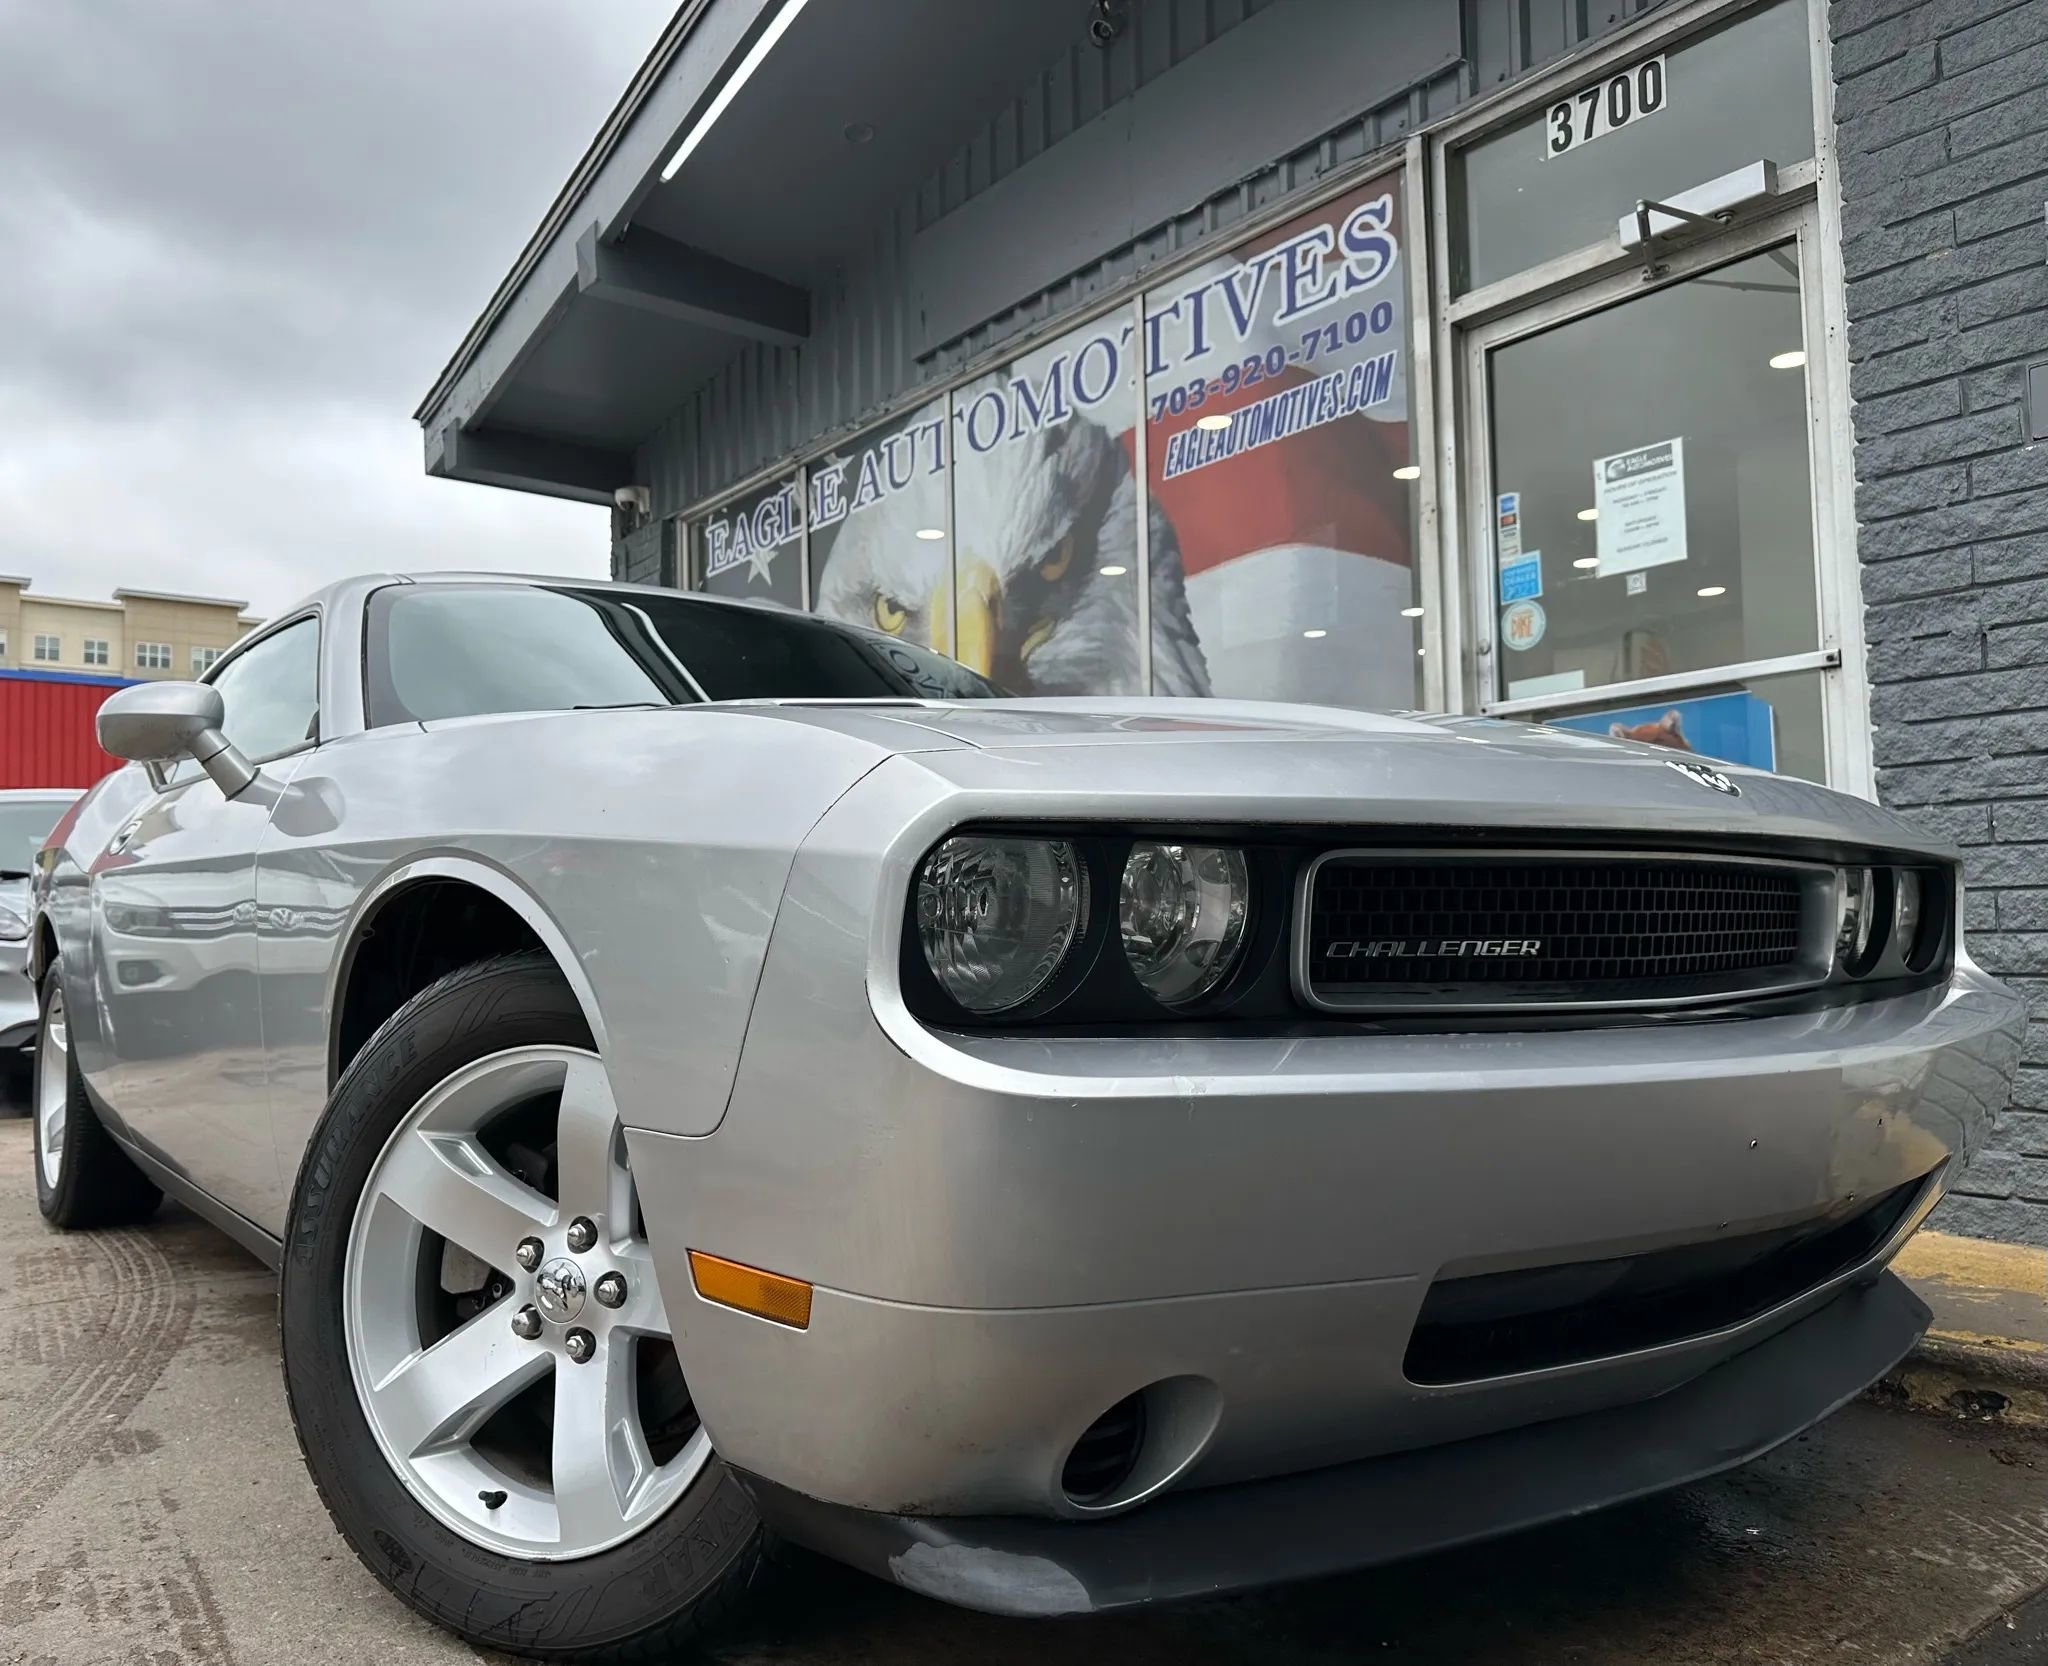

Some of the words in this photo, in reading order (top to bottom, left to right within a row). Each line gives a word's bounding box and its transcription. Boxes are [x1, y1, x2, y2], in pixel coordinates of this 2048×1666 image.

[1551, 60, 1662, 153] 3700
[706, 464, 848, 577] EAGLE
[851, 193, 1397, 513] AUTOMOTIVES
[1152, 301, 1394, 424] 703-920-7100
[1162, 351, 1398, 481] EAGLEAUTOMOTIVES.COM
[1326, 940, 1541, 957] CHALLENGER
